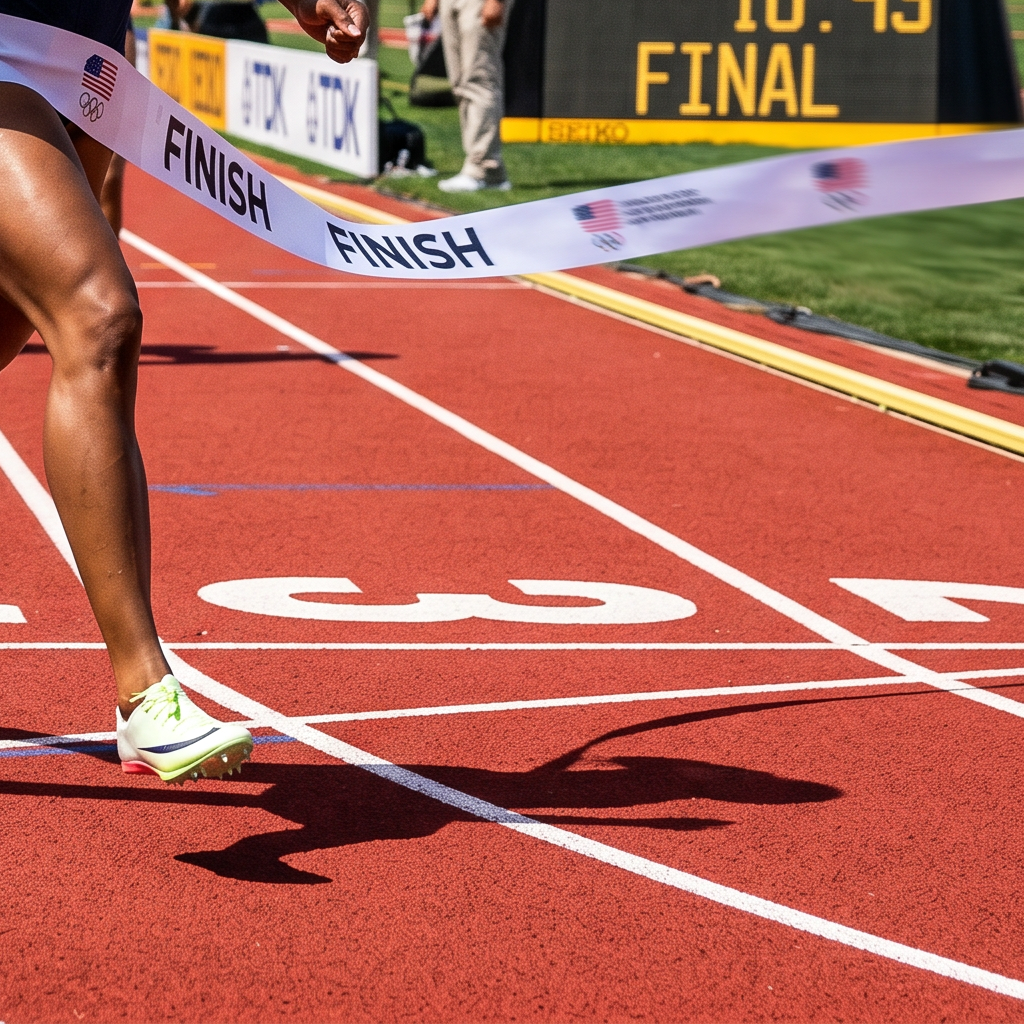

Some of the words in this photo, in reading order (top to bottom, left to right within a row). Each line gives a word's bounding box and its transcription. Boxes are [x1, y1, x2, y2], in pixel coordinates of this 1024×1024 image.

[636, 42, 839, 117] FINAL
[549, 122, 630, 142] SEIKO
[164, 115, 272, 231] FINISH
[326, 221, 495, 270] FINISH
[197, 577, 697, 624] 3
